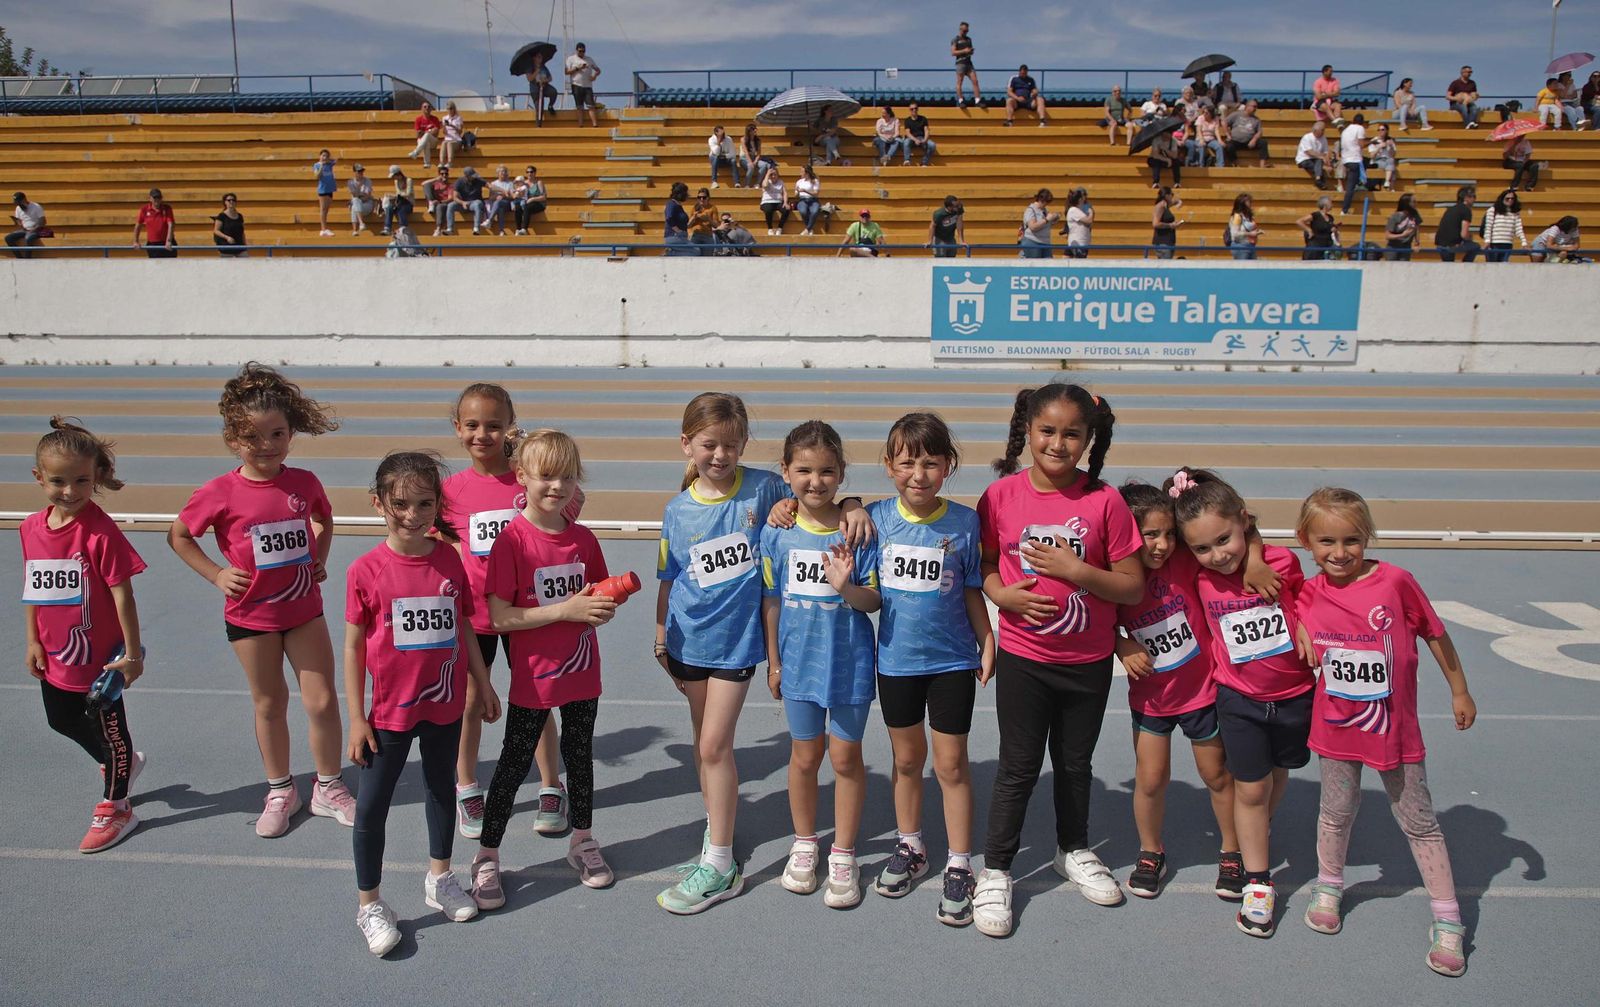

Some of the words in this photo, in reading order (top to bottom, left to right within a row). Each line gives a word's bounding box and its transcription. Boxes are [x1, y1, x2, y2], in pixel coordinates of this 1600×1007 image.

[1010, 276, 1080, 291] ESTADIO
[1083, 276, 1173, 292] MUNICIPAL
[1009, 293, 1156, 330] Enrique
[1163, 294, 1320, 325] Talavera
[940, 345, 995, 355] ATLETISMO
[1007, 346, 1072, 355] BALONMANO
[1084, 344, 1122, 356] FÚTBOL
[1125, 347, 1150, 356] SALA
[1163, 348, 1197, 356] RUGBY
[260, 529, 307, 553] 3368
[700, 542, 751, 574] 3432
[893, 556, 941, 581] 3419
[32, 569, 80, 589] 3369
[543, 573, 583, 599] 3349
[402, 608, 454, 632] 3353
[1231, 613, 1287, 645] 3322
[1144, 621, 1193, 657] 3354
[1314, 631, 1377, 643] INMACULADA
[1331, 659, 1386, 683] 3348
[106, 720, 129, 775] POWERFUL
